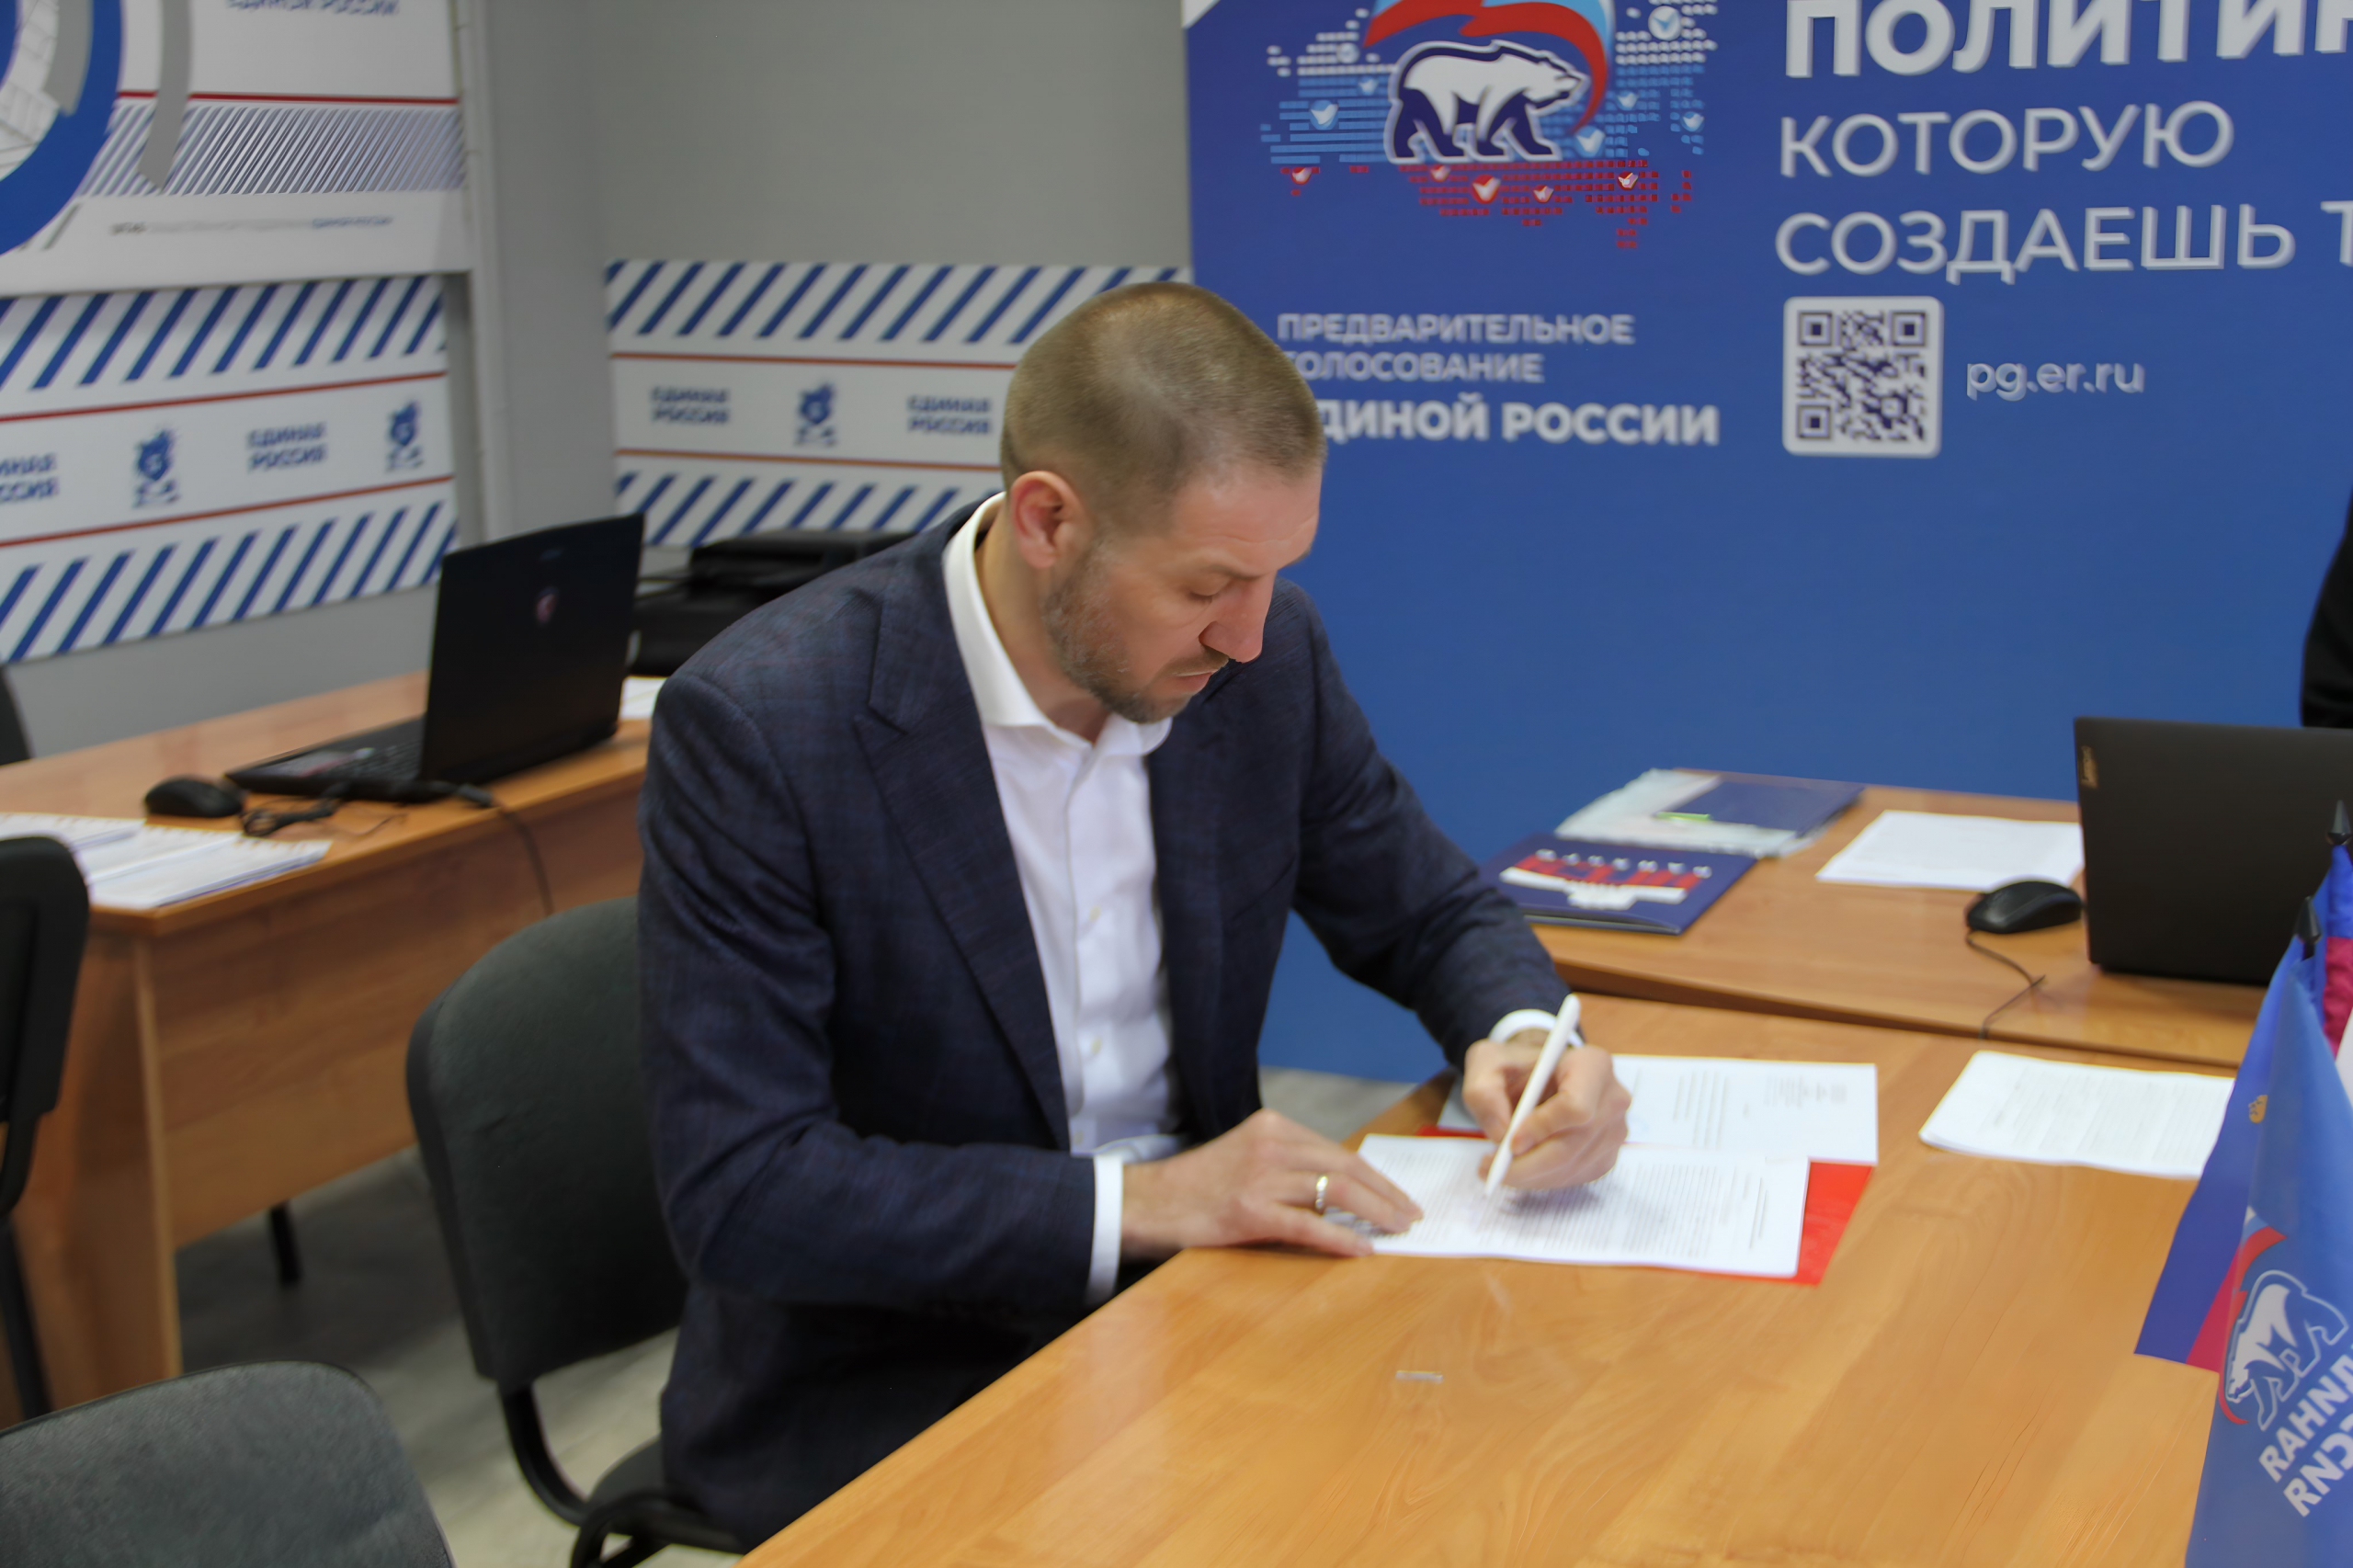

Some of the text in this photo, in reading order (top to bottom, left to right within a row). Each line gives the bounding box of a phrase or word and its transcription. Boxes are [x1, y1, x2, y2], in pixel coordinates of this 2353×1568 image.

[1780, 100, 2234, 177] КОТОРУЮ
[1775, 203, 2296, 285] СОЗДАЕШЬ
[1277, 313, 1636, 346] ПРЕДВАРИТЕЛЬНОЕ
[1966, 362, 2145, 402] pg.er.ru
[1316, 392, 1719, 446] ДИНОЙ РОССИИ
